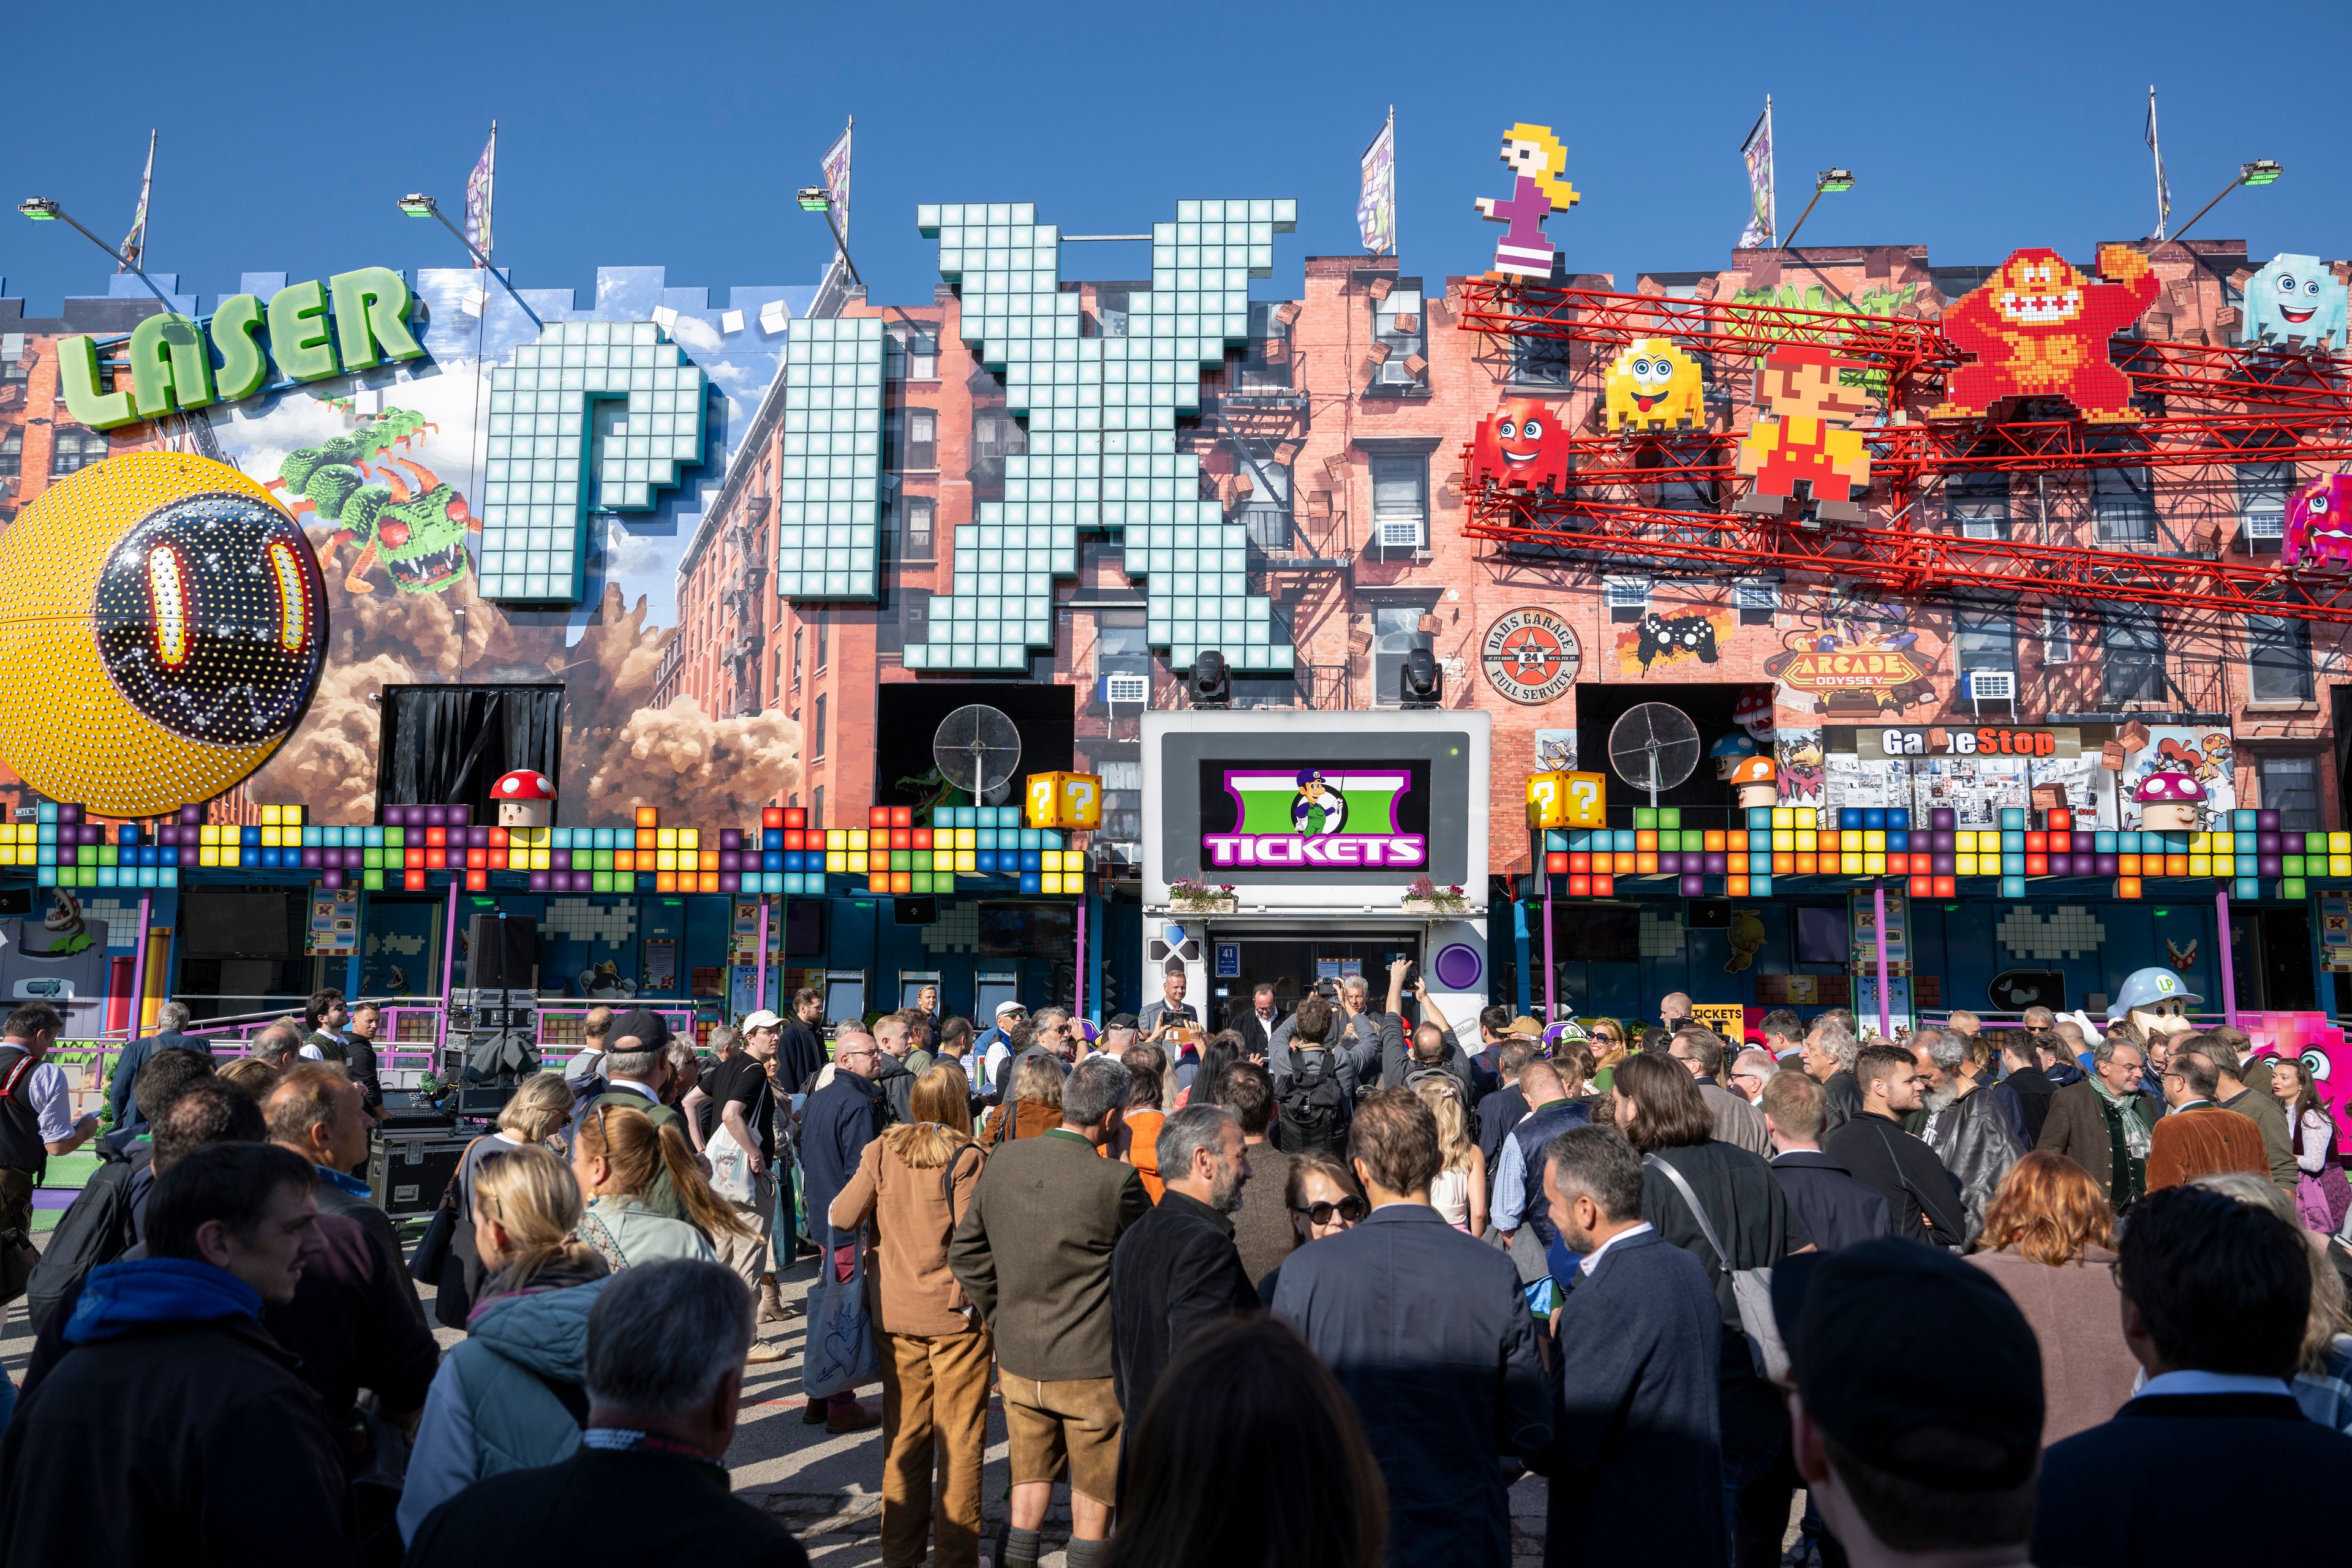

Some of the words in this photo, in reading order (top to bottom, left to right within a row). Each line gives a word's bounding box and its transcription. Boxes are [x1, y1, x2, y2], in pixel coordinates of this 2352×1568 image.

[58, 267, 426, 430] LASER
[1488, 616, 1520, 650] DAD'S
[1523, 614, 1574, 649] GARAGE
[1524, 654, 1538, 662] 24
[1798, 655, 1902, 674] ARCADE
[1491, 669, 1518, 696] FULL
[1522, 669, 1572, 700] SERVICE
[1816, 676, 1884, 685] ODYSSEY
[1208, 838, 1421, 861] TICKETS
[1222, 948, 1233, 958] 41
[2158, 979, 2174, 991] LP
[1692, 1009, 1742, 1019] TICKETS
[1454, 1025, 1466, 1035] ART
[1564, 1028, 1578, 1039] LP
